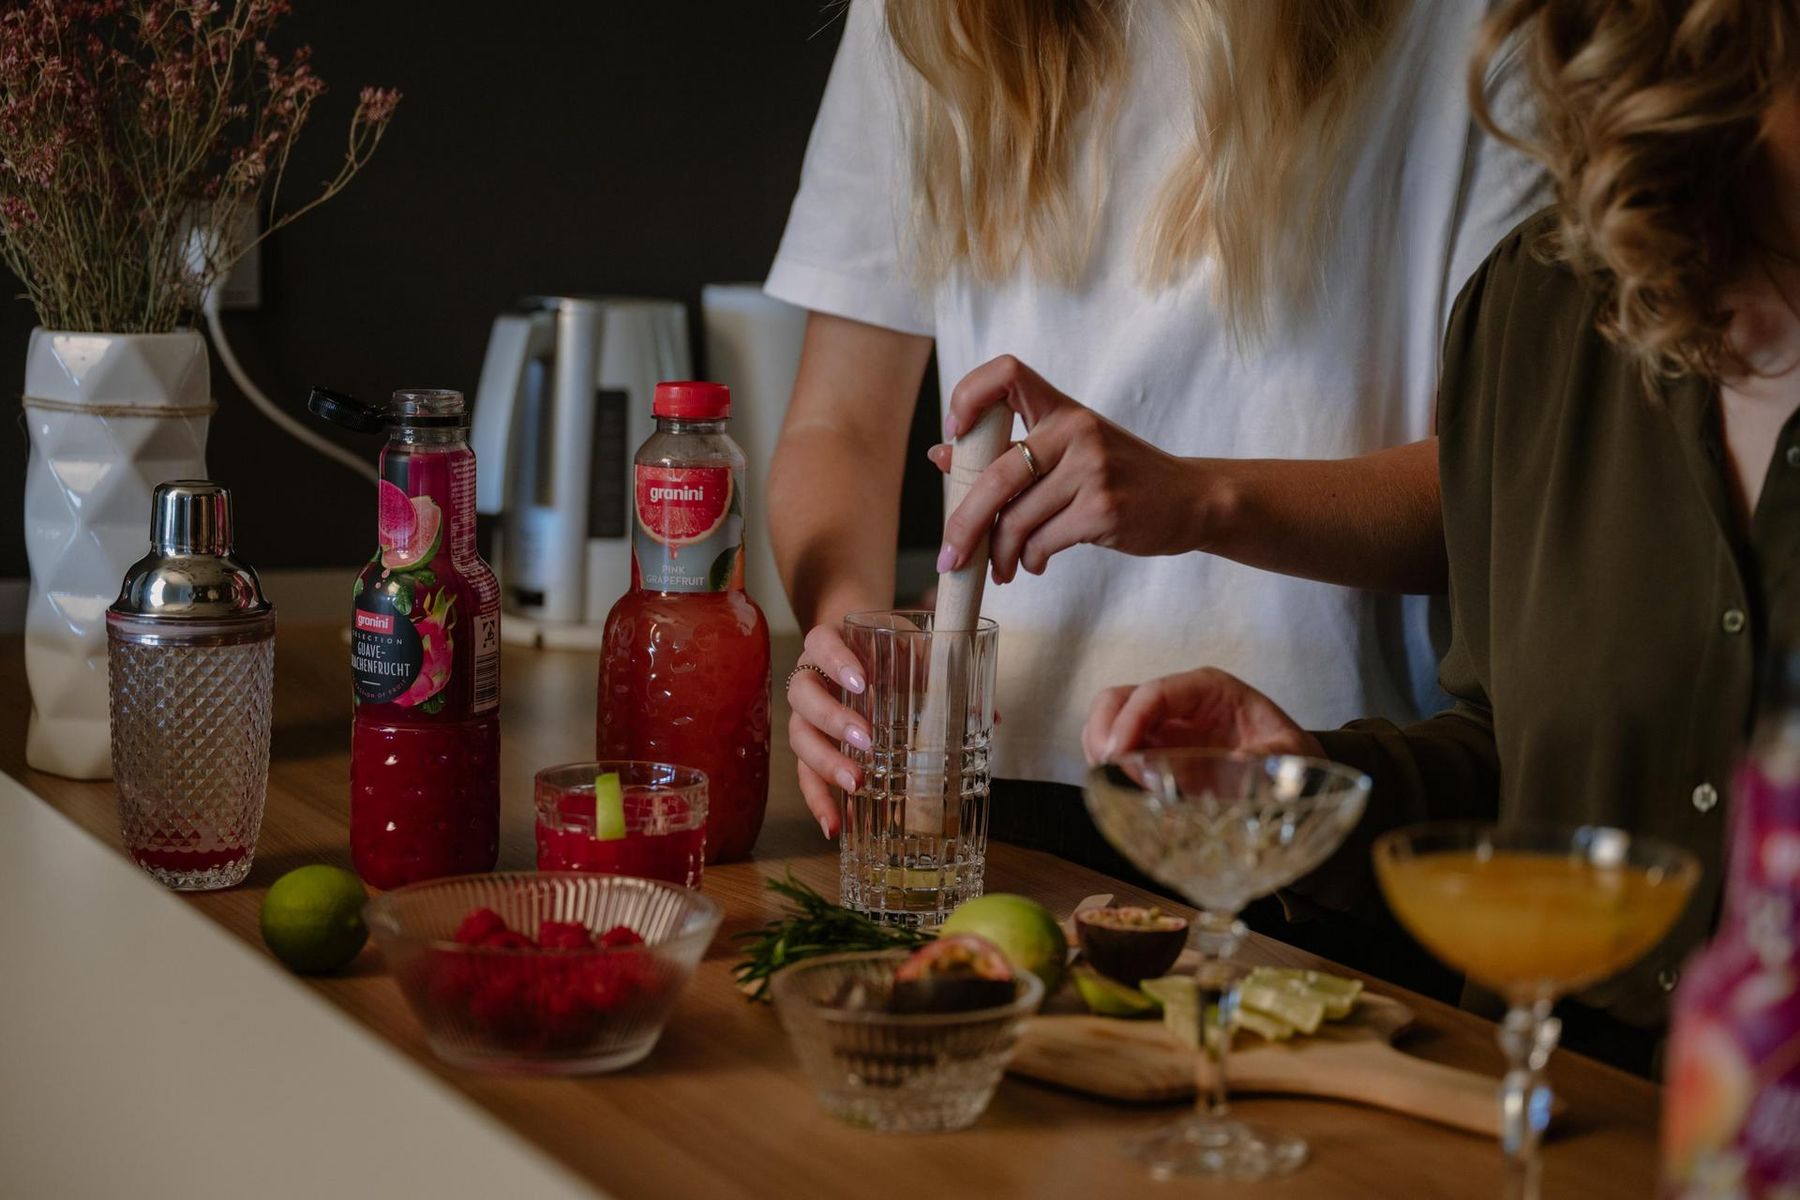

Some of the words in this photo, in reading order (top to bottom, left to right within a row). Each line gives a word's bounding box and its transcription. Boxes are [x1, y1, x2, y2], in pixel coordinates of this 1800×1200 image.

[650, 486, 704, 502] granini
[662, 565, 685, 574] PINK
[646, 575, 705, 586] GRAPEFRUIT
[357, 614, 389, 629] granini
[357, 641, 386, 659] GUAVE-
